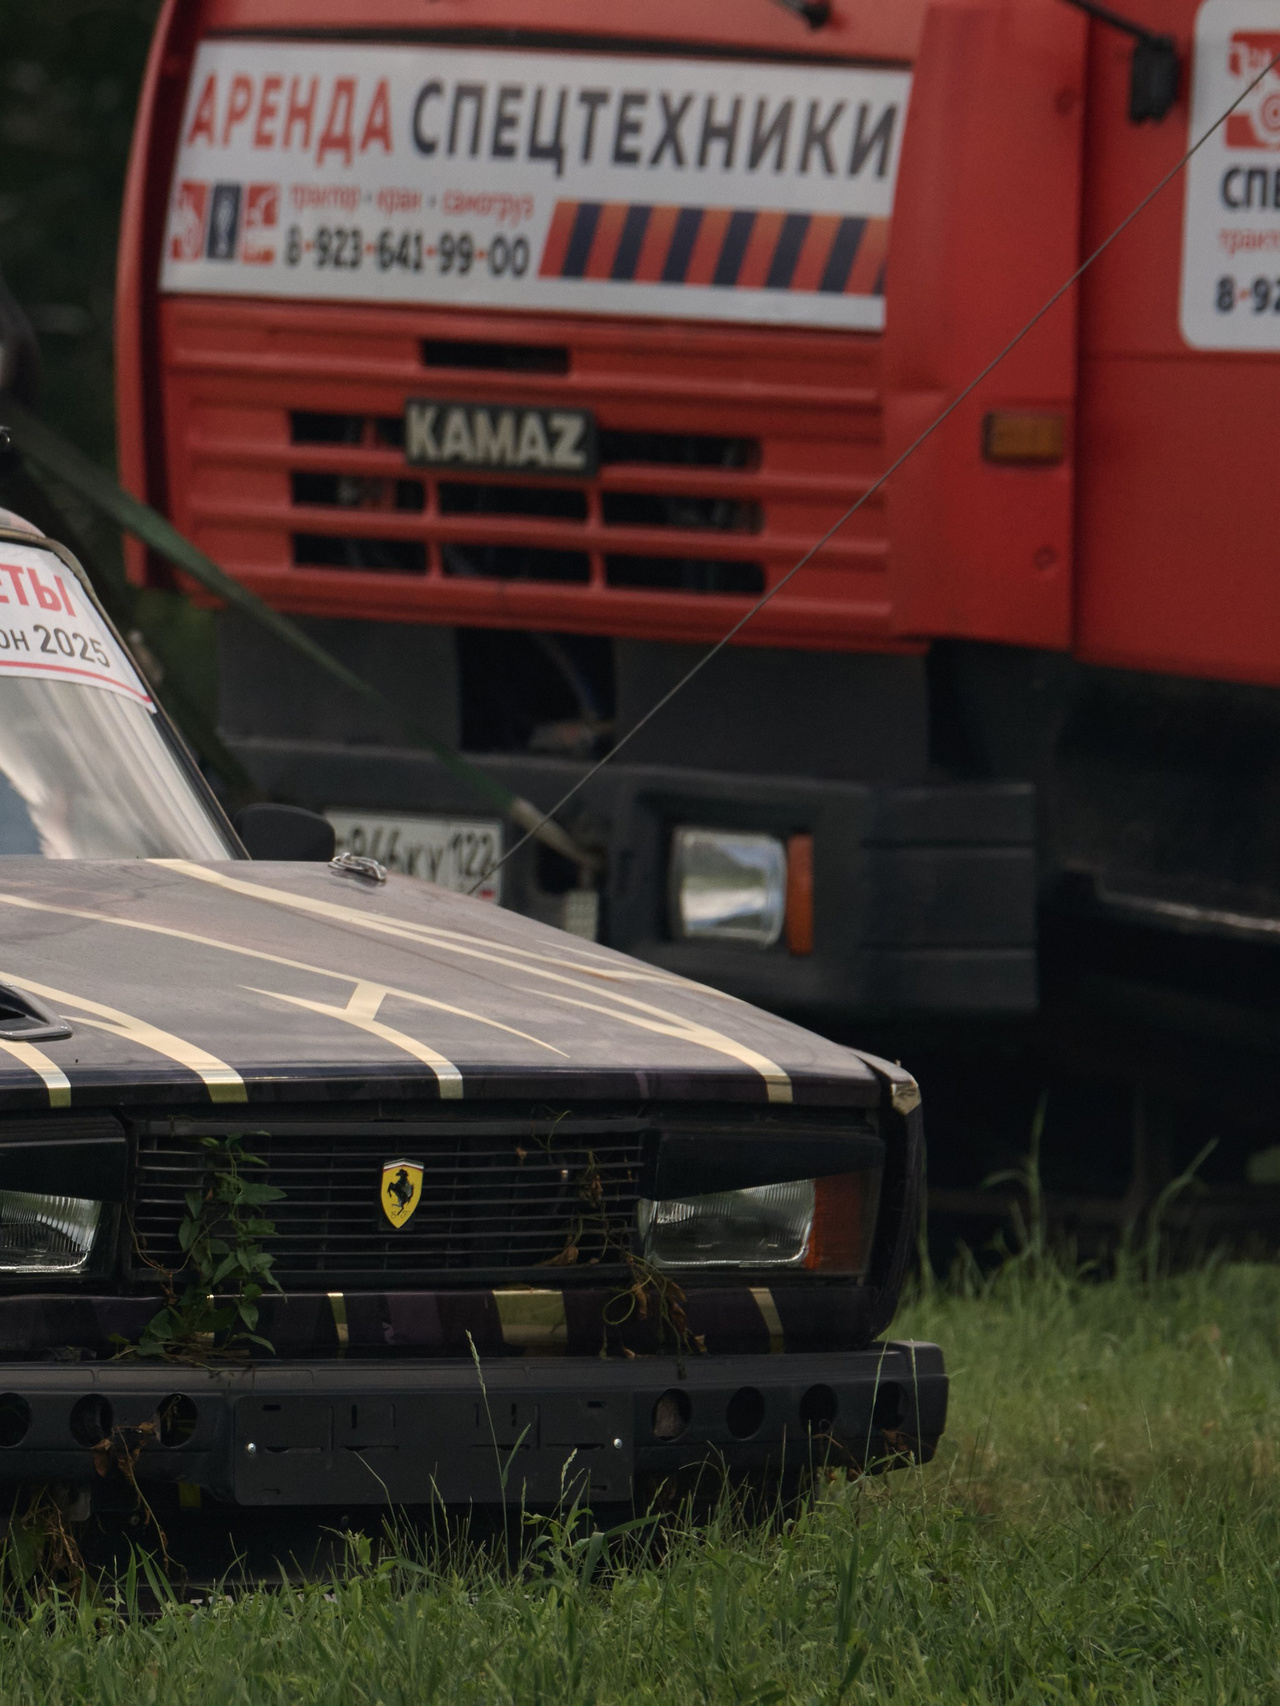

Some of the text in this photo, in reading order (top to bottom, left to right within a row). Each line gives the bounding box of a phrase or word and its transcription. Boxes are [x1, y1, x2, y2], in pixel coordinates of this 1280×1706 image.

[188, 73, 899, 180] АРЕНДА СПЕЦТЕХНИКИ
[376, 188, 423, 216] кран
[407, 404, 586, 469] KAMAZ
[33, 624, 111, 668] 2025
